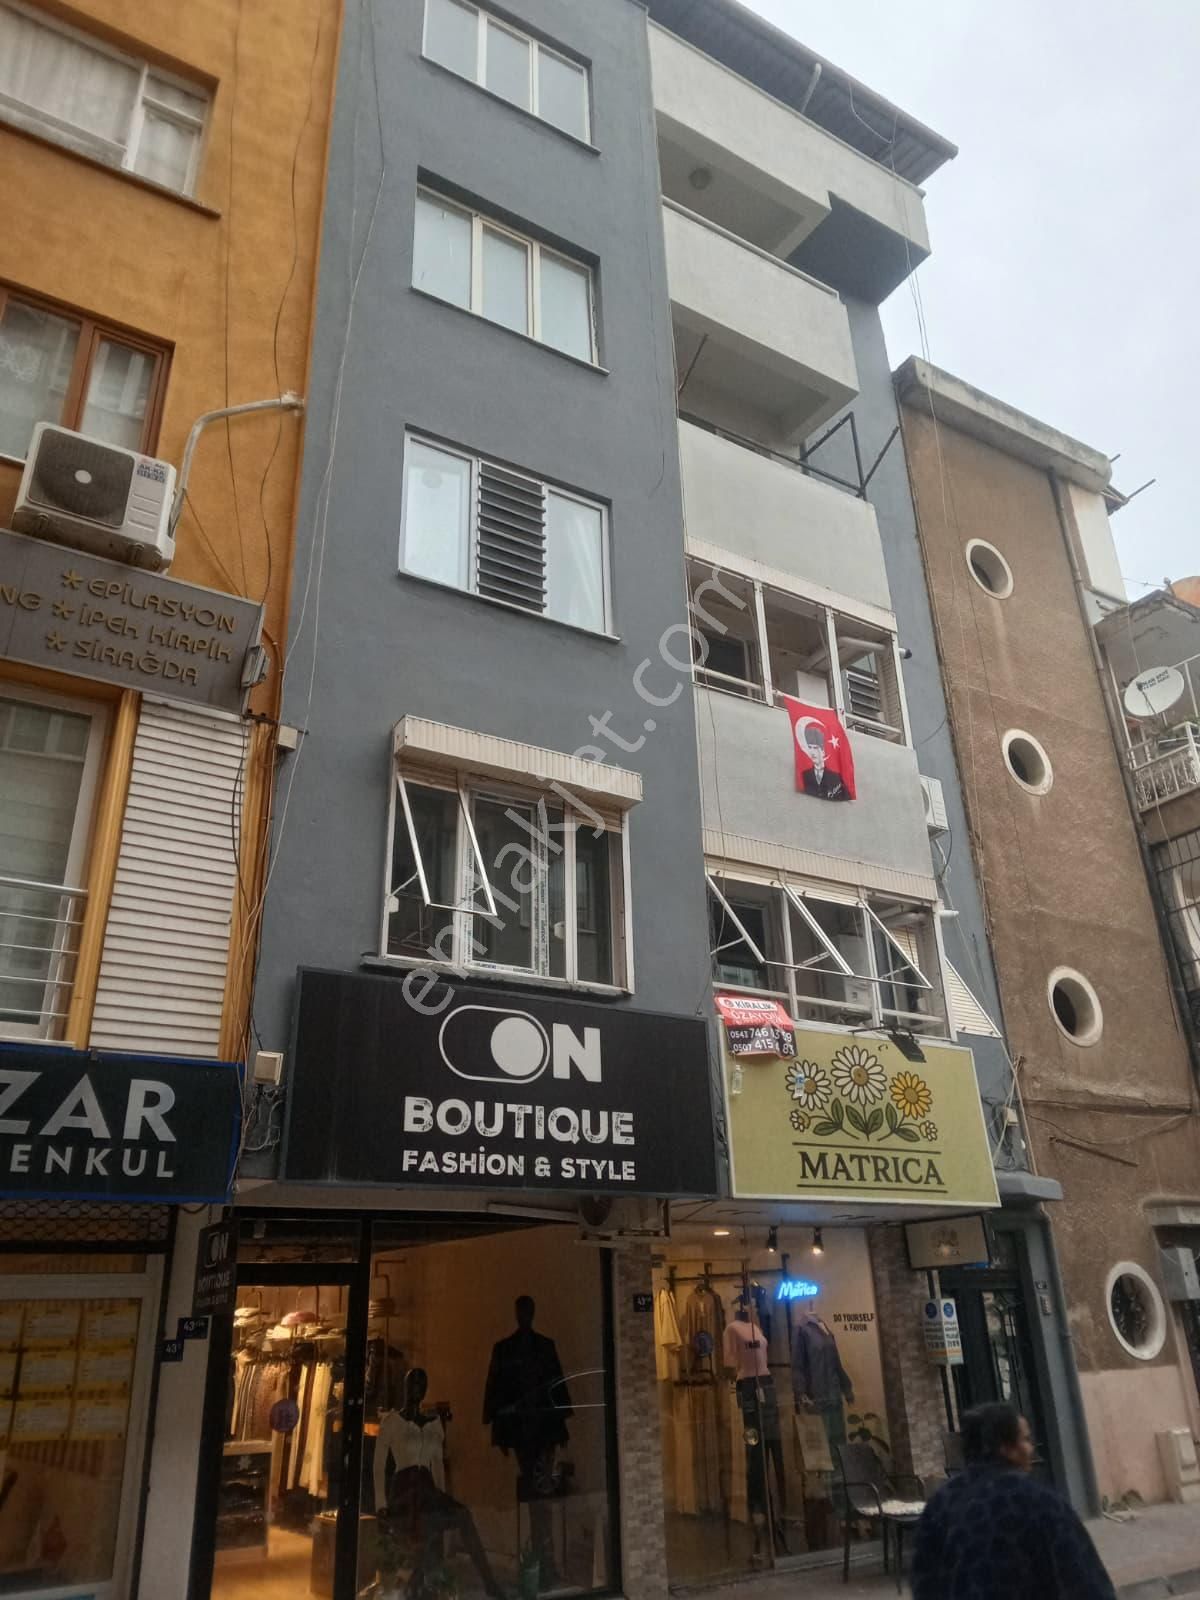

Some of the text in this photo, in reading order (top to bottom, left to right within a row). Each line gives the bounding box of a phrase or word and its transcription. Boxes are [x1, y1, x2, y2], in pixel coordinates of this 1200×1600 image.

[88, 578, 236, 634] EPİLASYON
[438, 1004, 602, 1085] ON
[749, 1027, 769, 1038] 746
[755, 1039, 774, 1050] 415
[403, 1096, 636, 1145] BOUTIQUE
[9, 1144, 174, 1178] ENKUL
[534, 1156, 551, 1177] &
[560, 1157, 636, 1181] STYLE
[798, 1151, 945, 1186] MATRICA
